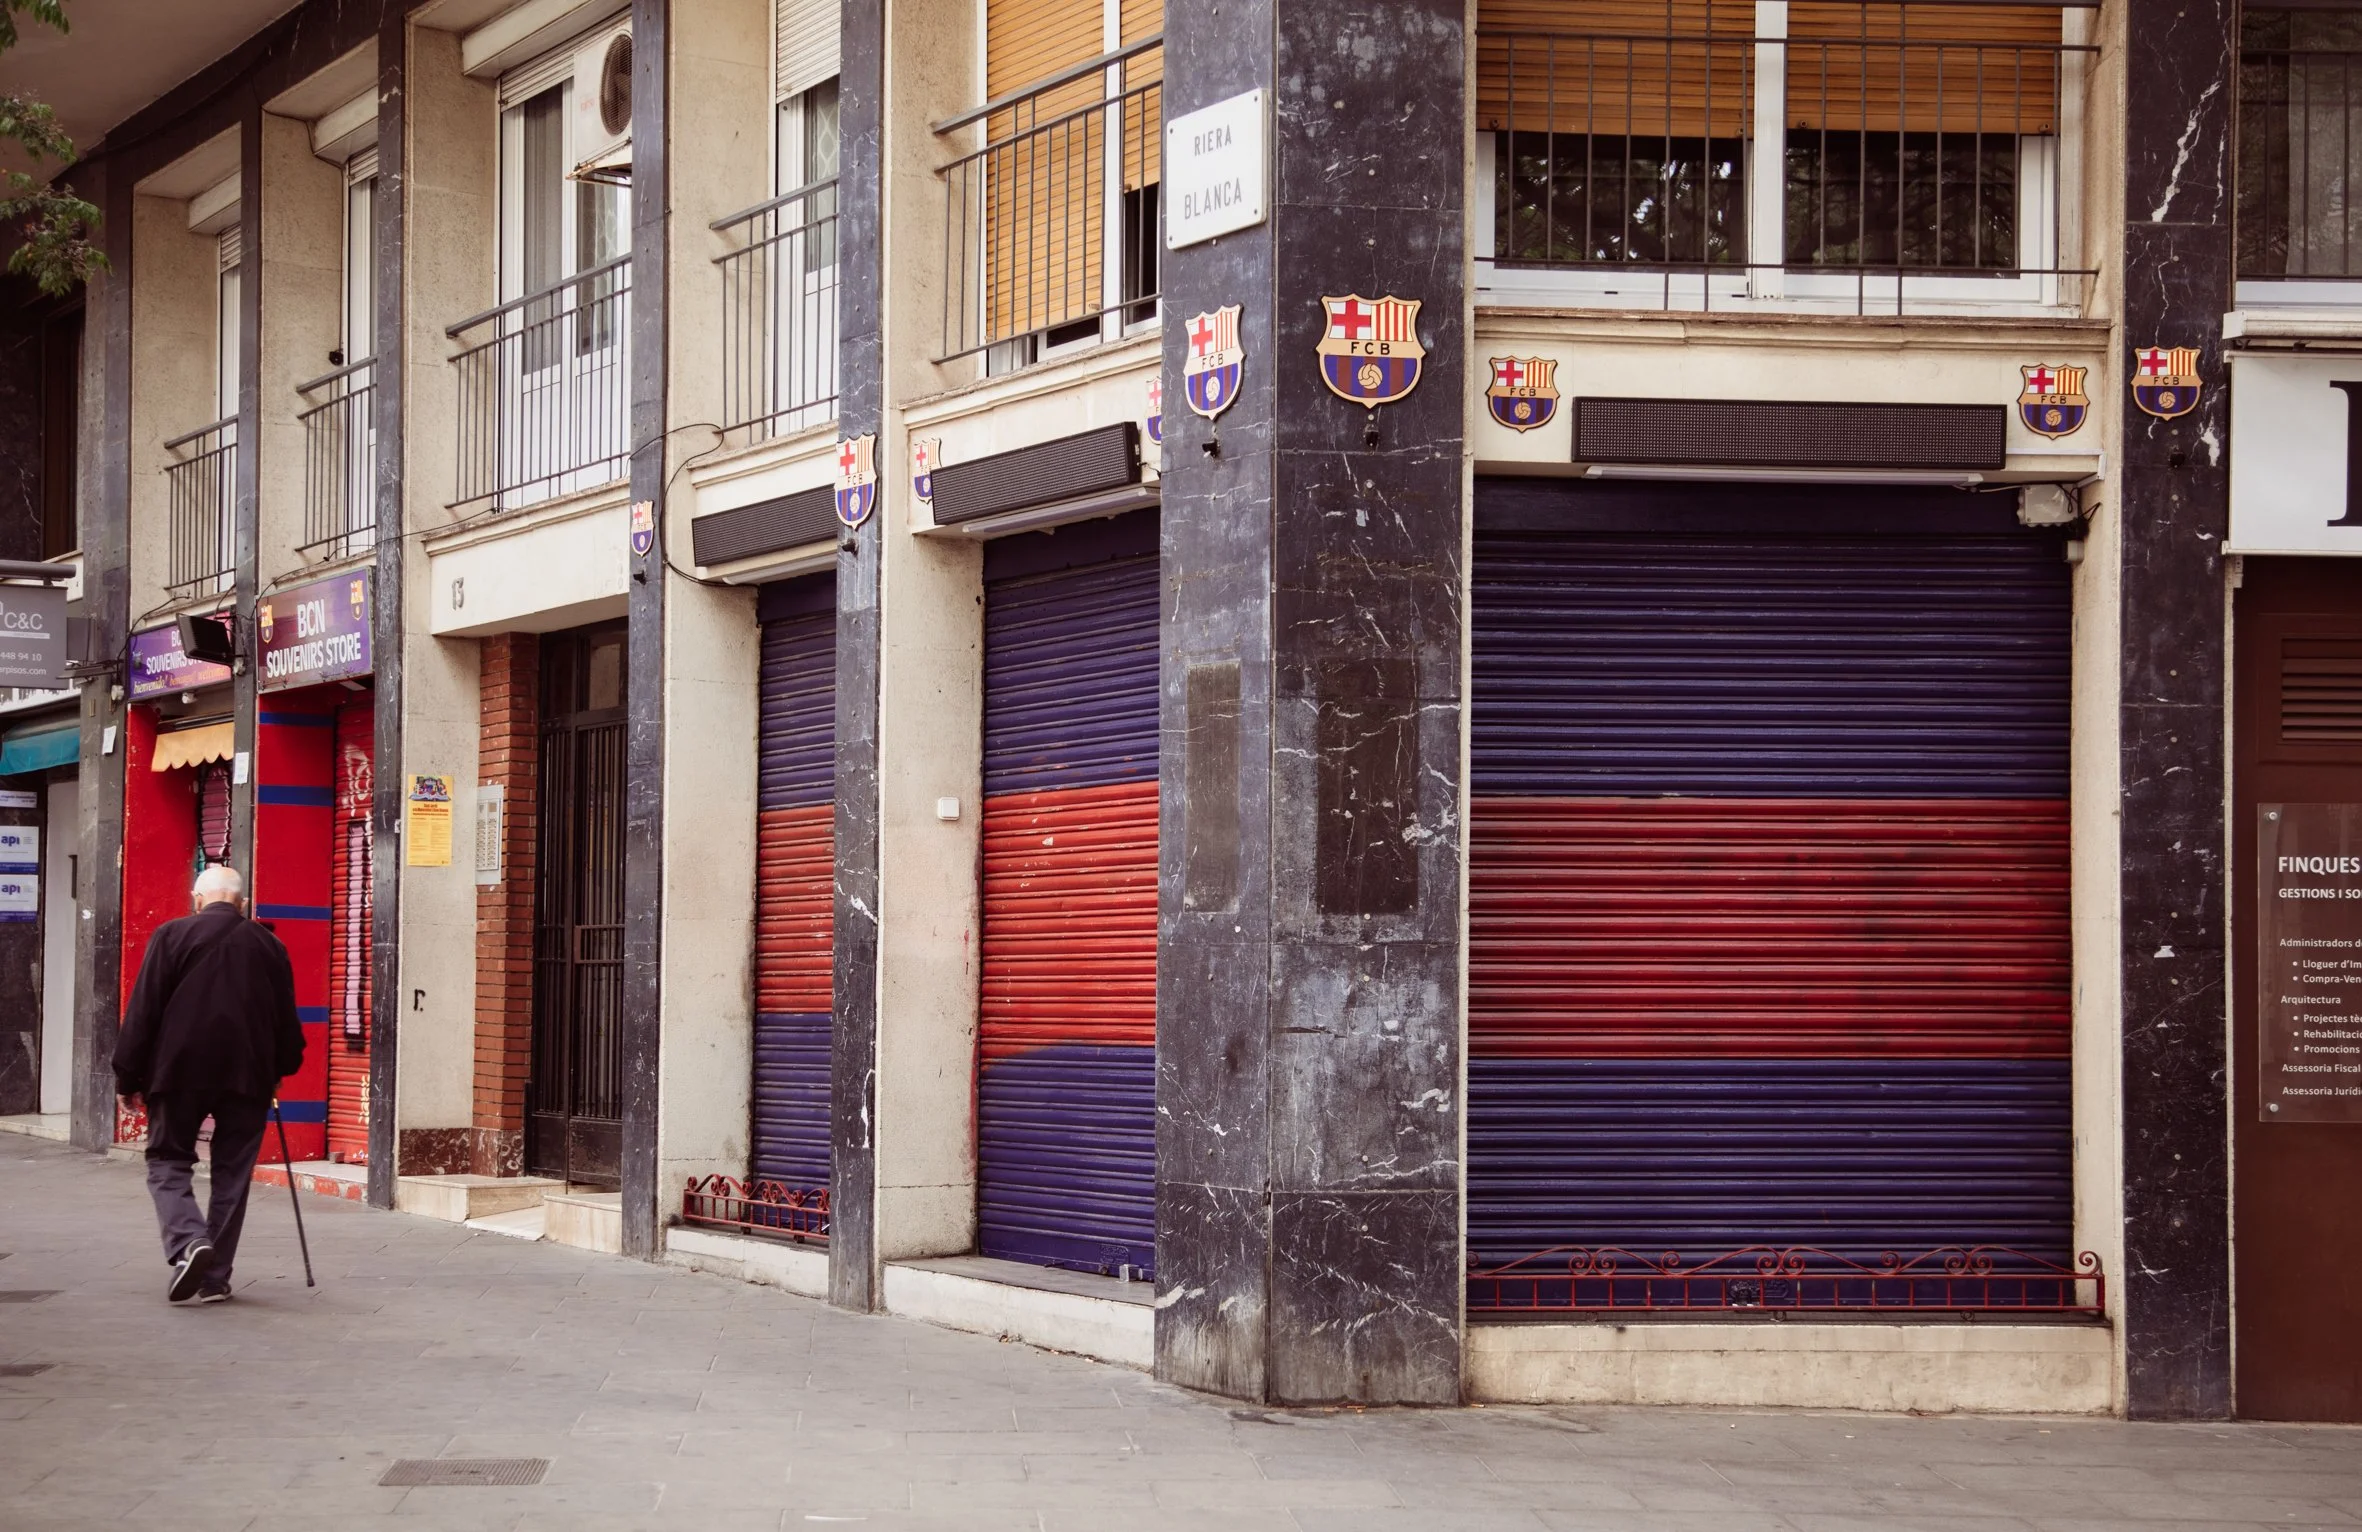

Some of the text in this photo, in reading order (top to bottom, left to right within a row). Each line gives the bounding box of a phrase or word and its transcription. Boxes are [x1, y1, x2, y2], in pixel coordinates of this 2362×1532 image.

[1194, 124, 1232, 157] RIERA
[1184, 177, 1242, 220] BLANCA
[1351, 341, 1390, 355] FCB
[1201, 353, 1225, 369] FCB
[2153, 376, 2180, 385] FCB
[1510, 387, 1537, 397] FCB
[2040, 395, 2067, 404] FCB
[847, 473, 863, 486] FCB
[4, 612, 43, 630] C&C
[297, 598, 326, 638] BCN
[32, 653, 42, 662] 10
[266, 631, 362, 678] SOUVENIRS STORE
[146, 649, 187, 675] SOUVENIRS
[2278, 856, 2361, 876] FINQUES
[2278, 888, 2362, 899] GESTIONS I SO
[2279, 938, 2362, 948] Administradors d
[2302, 959, 2338, 970] Lloguer
[2302, 974, 2362, 985] Compra-Ven
[2280, 995, 2341, 1006] Arquitectura
[2303, 1013, 2348, 1024] Projectes
[2304, 1044, 2360, 1054] Promocions
[2281, 1063, 2361, 1073] Assessoria Fiscal
[2282, 1086, 2362, 1096] Assessoria Jurídi
